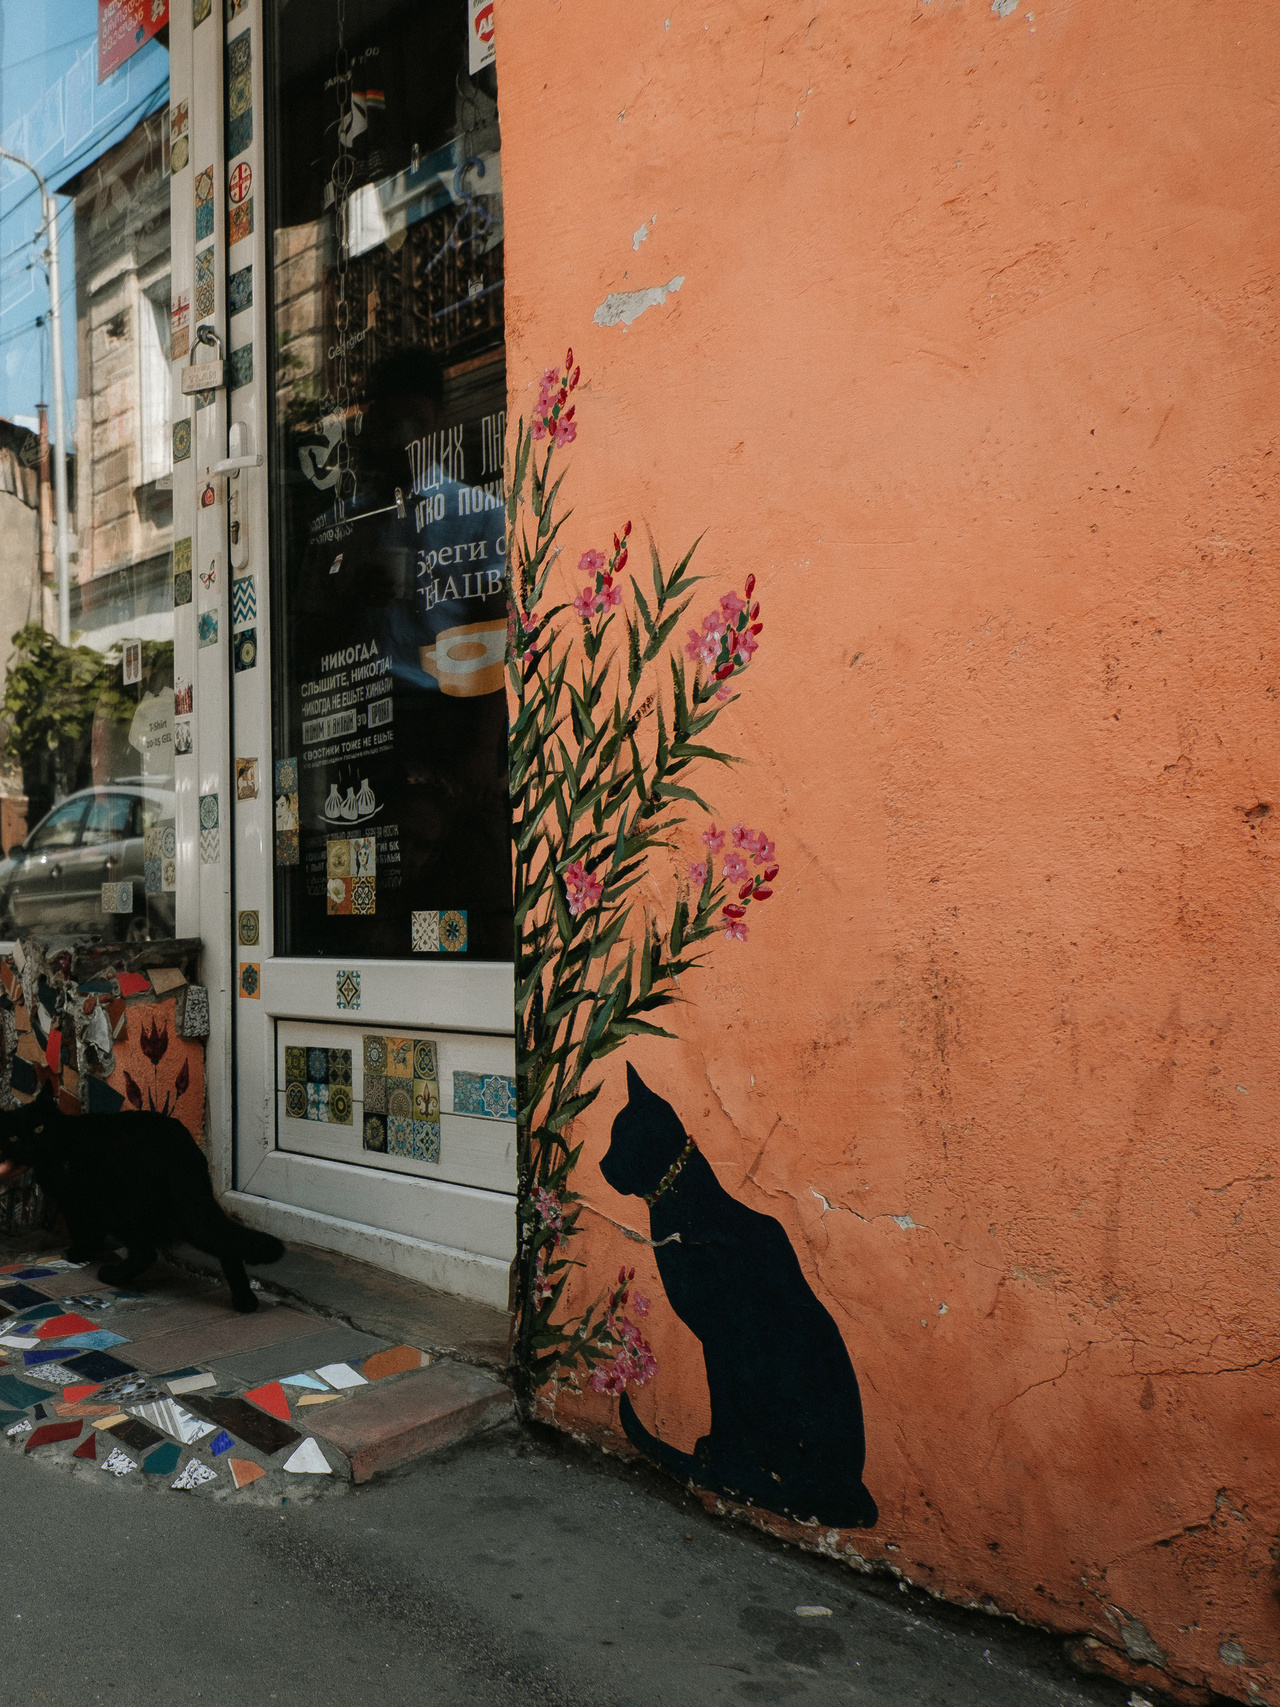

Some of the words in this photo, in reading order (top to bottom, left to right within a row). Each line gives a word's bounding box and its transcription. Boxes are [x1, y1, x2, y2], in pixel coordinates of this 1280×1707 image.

[321, 638, 379, 672] НИКОГДА
[301, 672, 349, 697] СЛЫШИТЕ,
[351, 655, 392, 683] НИКОГДА!
[302, 697, 331, 716] НИКОГДА
[332, 693, 341, 710] НЕ
[342, 686, 364, 706] ЕШЬТЕ
[365, 676, 393, 700] ХИНКАЛИ
[161, 732, 173, 743] GEL
[341, 736, 361, 753] ТОЖЕ
[363, 734, 372, 747] НЕ
[373, 730, 394, 745] ЕШЬТЕ
